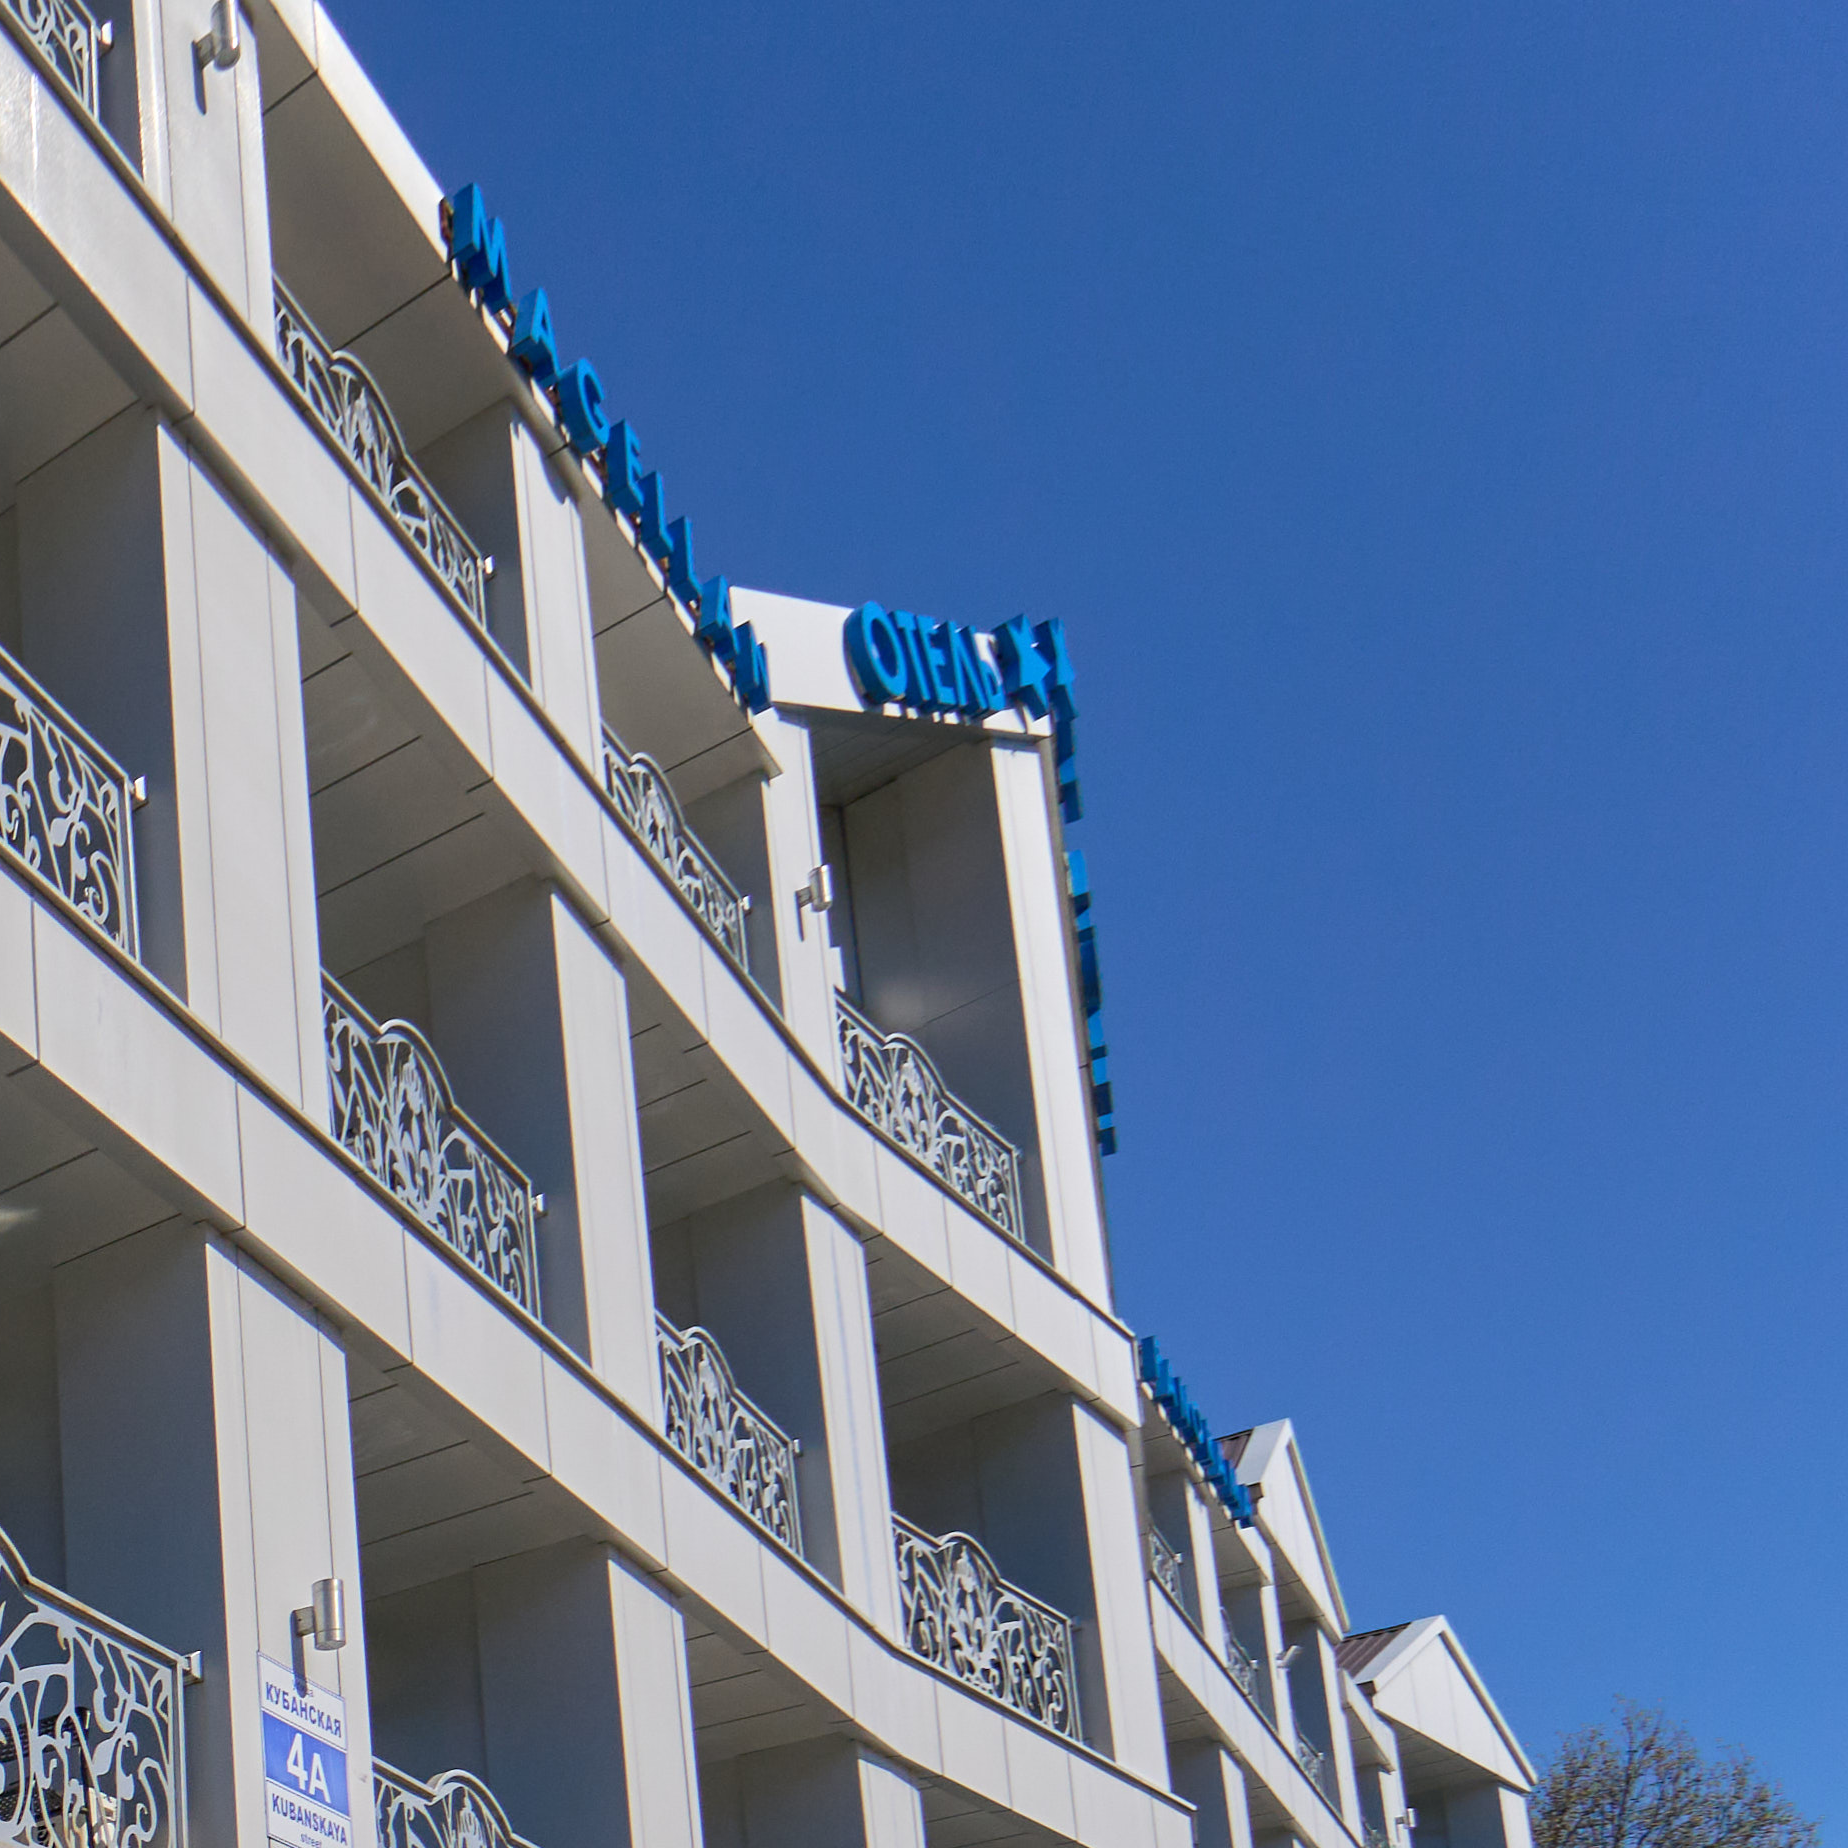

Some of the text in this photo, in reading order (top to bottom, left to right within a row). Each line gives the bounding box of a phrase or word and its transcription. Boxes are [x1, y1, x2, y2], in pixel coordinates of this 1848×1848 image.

[843, 601, 1005, 711] ОТЕЛЬ
[265, 1681, 342, 1738] КУБАНСКАЯ
[286, 1733, 331, 1804] 4А
[272, 1793, 348, 1846] KUBANSKAYA
